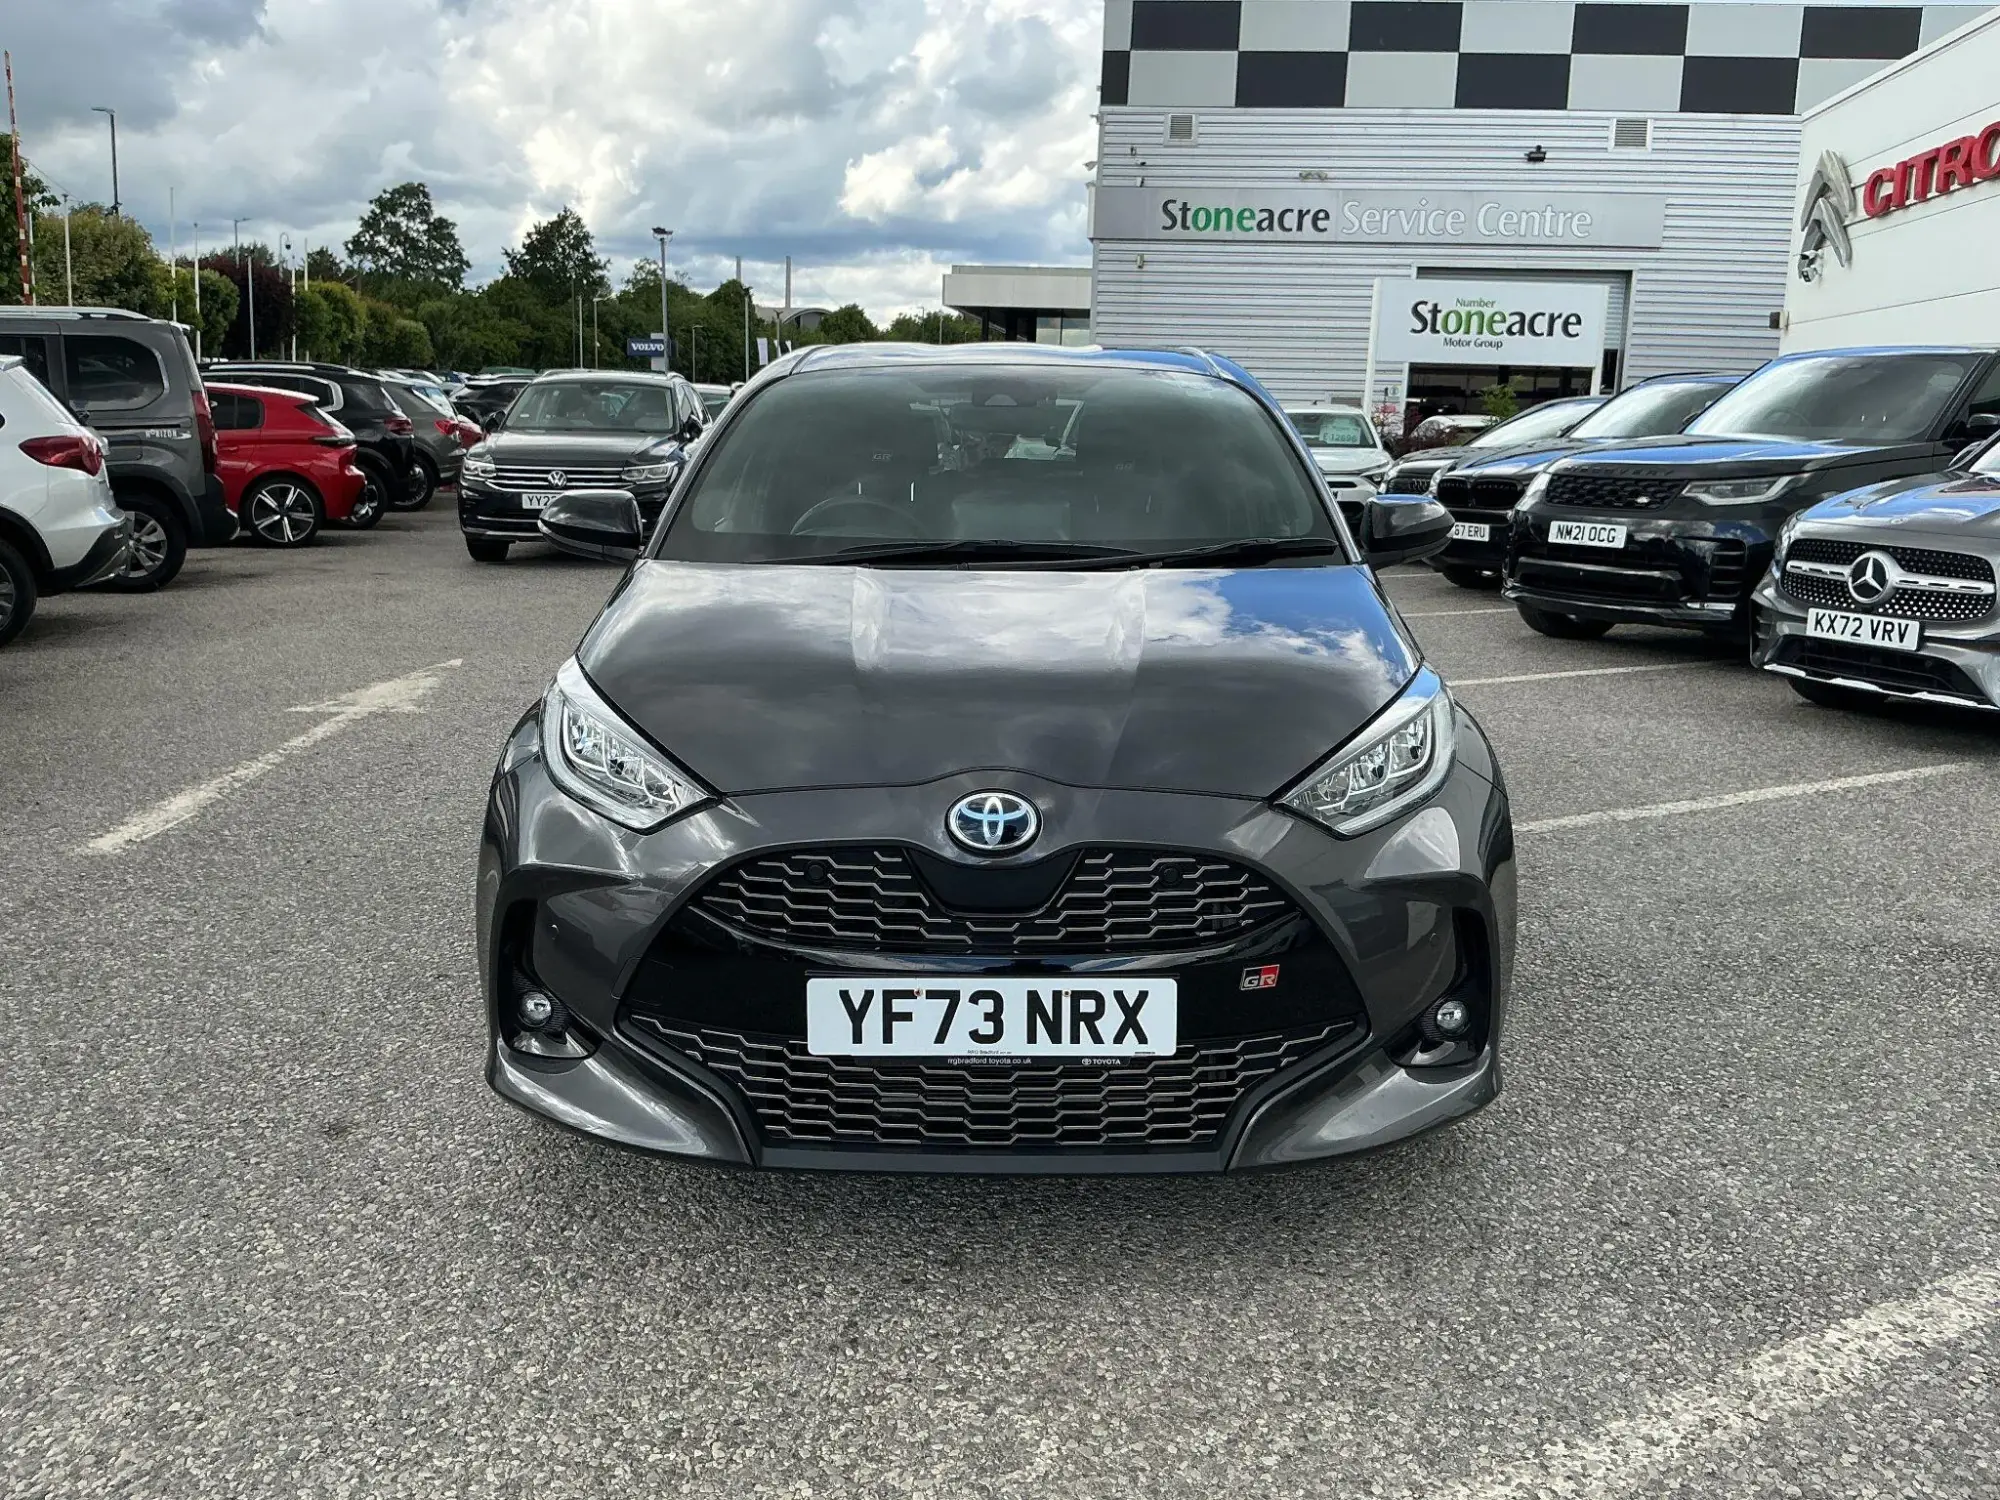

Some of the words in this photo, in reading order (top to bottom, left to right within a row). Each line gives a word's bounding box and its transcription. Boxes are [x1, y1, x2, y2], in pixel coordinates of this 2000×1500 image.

[1161, 199, 1330, 233] Stoneacre
[1341, 198, 1466, 236] Service
[1476, 202, 1592, 238] Centre
[1455, 297, 1496, 308] Number
[1410, 300, 1582, 338] Stoneacre
[631, 342, 664, 351] VOLVO
[1443, 337, 1471, 348] Motor
[1474, 338, 1503, 350] Group
[528, 495, 557, 506] YY2
[1468, 525, 1486, 538] ERU
[1556, 524, 1585, 541] NM21
[1588, 526, 1617, 543] OCG
[1814, 612, 1862, 638] KX72
[1870, 619, 1909, 643] VRV
[839, 989, 1004, 1044] YF73
[1026, 989, 1149, 1044] NRX
